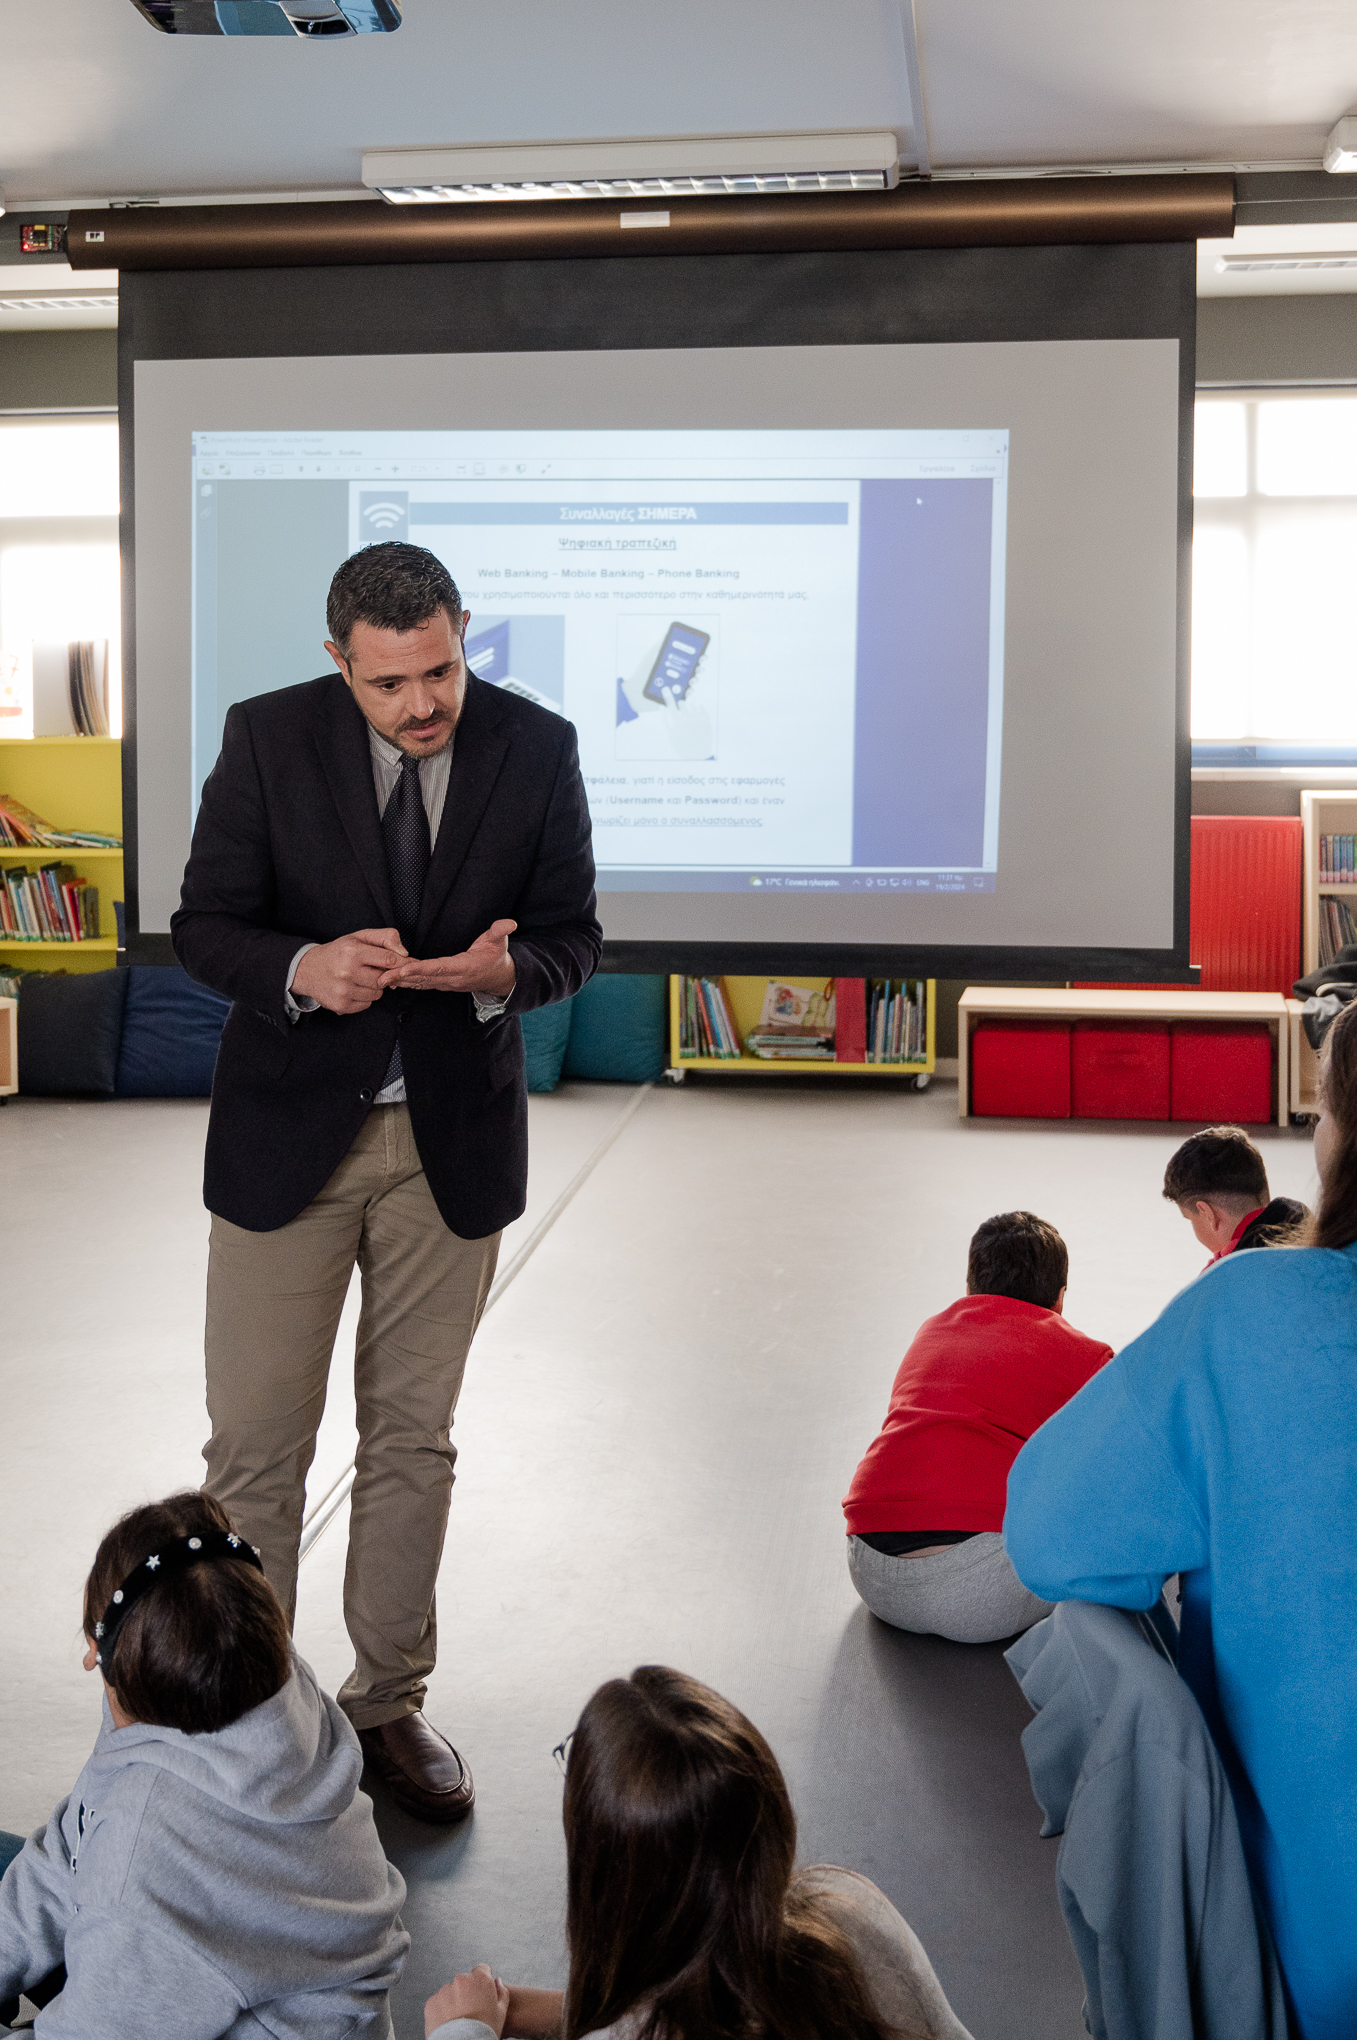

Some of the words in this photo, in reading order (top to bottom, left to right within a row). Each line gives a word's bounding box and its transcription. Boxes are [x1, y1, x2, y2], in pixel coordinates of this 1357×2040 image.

[559, 506, 635, 522] Συναλλαγές
[637, 507, 698, 520] ΣΗΜΕΡΑ
[558, 536, 612, 551] Ψηφιακή
[616, 536, 677, 551] τραπεζική
[477, 568, 502, 578] Web
[504, 568, 549, 581] Banking
[561, 568, 597, 578] Mobile
[600, 568, 645, 581] Banking
[657, 568, 692, 579] Phone
[695, 568, 741, 581] Banking
[482, 589, 571, 602] χρησιμοποιούνται
[573, 589, 592, 600] όλο
[594, 590, 610, 600] και
[613, 589, 677, 602] περισσότερο
[679, 590, 704, 602] στην
[633, 775, 656, 787] γιατί
[657, 777, 665, 787] η
[667, 774, 706, 788] είσοδος
[708, 776, 729, 788] στις
[731, 775, 787, 788] εφαρμογές
[605, 795, 665, 807] (Username
[667, 797, 683, 806] και
[684, 795, 743, 807] Password)
[744, 797, 760, 806] και
[762, 795, 787, 806] έναν
[633, 815, 660, 828] μόνο
[915, 878, 930, 887] ENG
